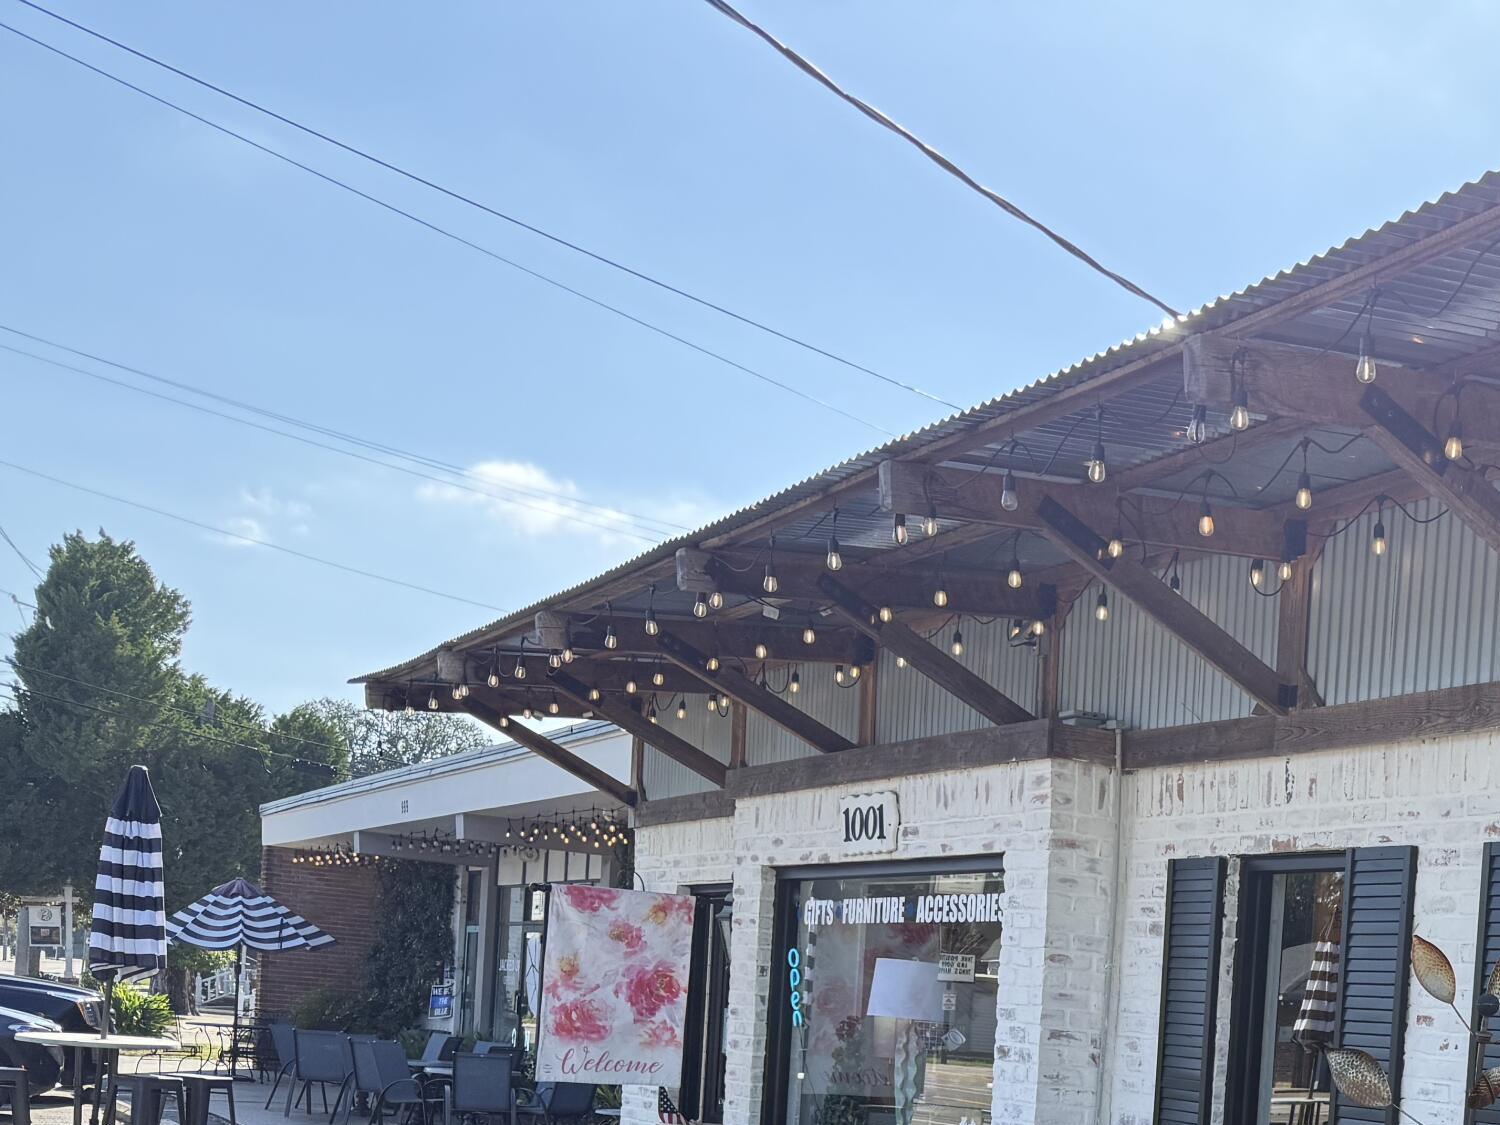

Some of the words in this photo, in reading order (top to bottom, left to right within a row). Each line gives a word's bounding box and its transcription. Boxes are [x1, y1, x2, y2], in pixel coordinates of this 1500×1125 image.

[842, 803, 887, 843] 1001
[804, 898, 834, 925] GIFTS
[842, 896, 906, 924] FURNITURE
[555, 1046, 664, 1075] Welcome
